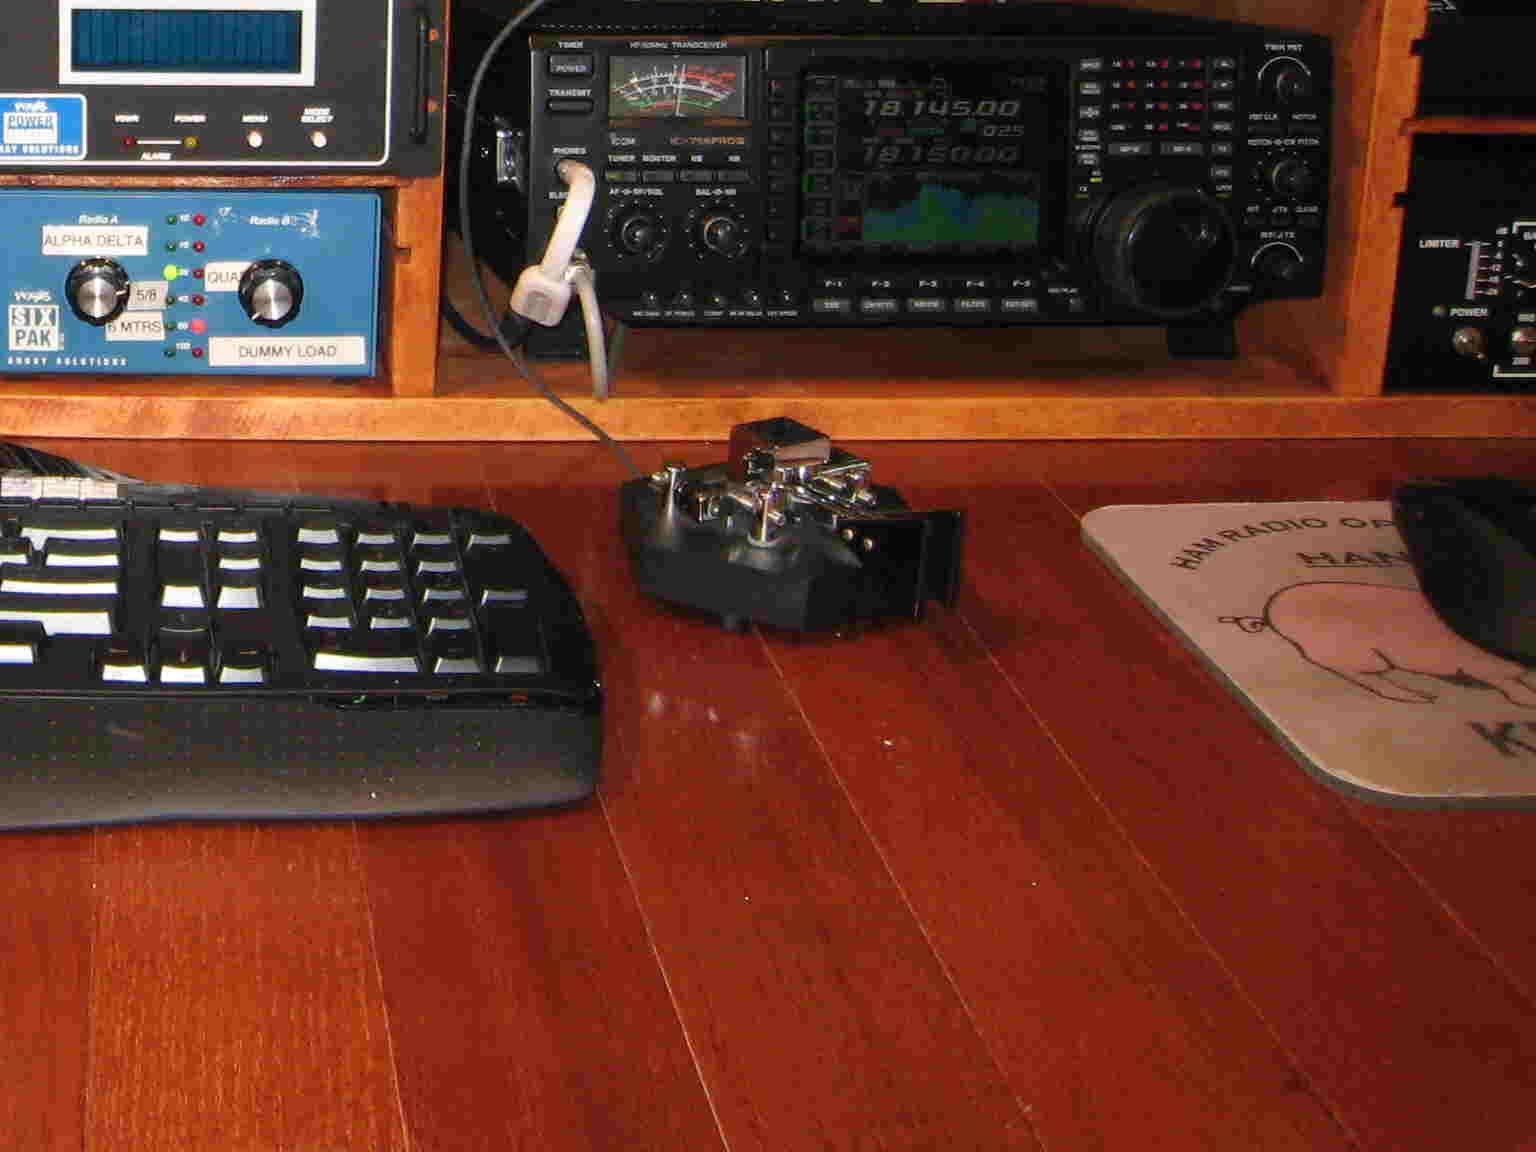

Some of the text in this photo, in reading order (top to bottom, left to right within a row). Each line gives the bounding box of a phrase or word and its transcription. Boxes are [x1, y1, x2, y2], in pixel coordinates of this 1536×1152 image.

[8, 114, 53, 129] POWER
[79, 214, 120, 225] Radio A
[250, 215, 279, 226] Radio
[44, 233, 145, 247] ALPHA DELTA
[12, 306, 56, 327] SIX
[1449, 307, 1489, 318] POWER
[121, 320, 162, 334] MTRS
[15, 329, 52, 346] PAK
[238, 343, 337, 358] DUMMY LOAD
[7, 355, 129, 367] ARRAY SOLUTIONS
[1169, 538, 1224, 571] HAM
[1220, 517, 1329, 545] RADIO
